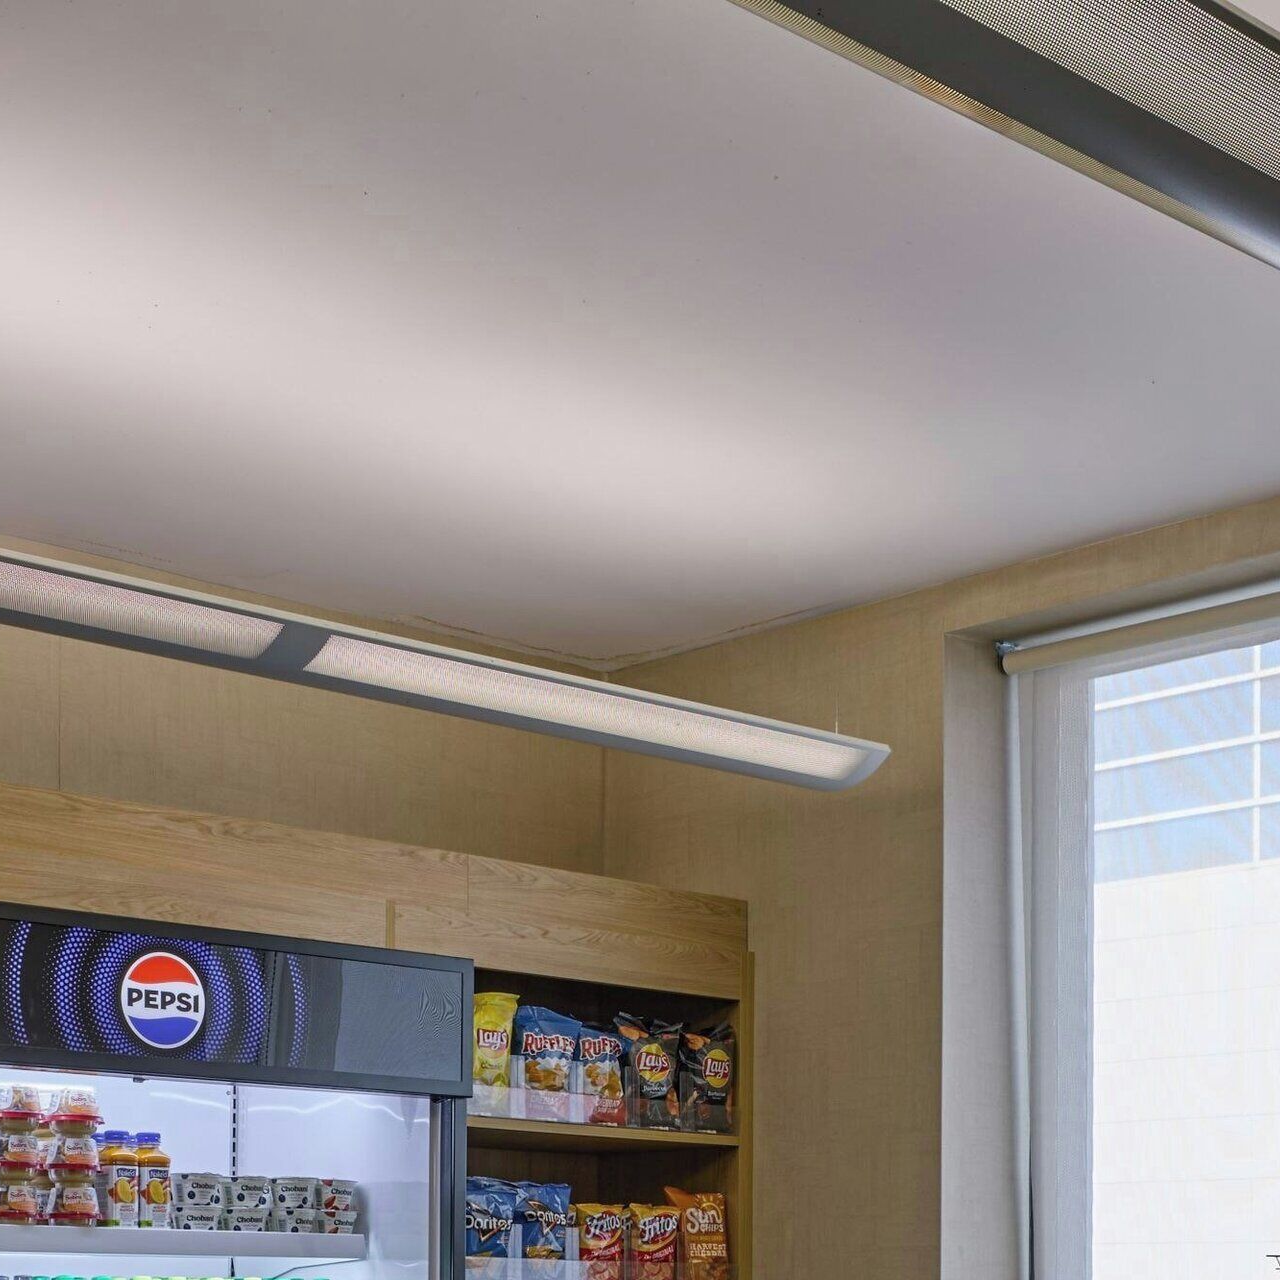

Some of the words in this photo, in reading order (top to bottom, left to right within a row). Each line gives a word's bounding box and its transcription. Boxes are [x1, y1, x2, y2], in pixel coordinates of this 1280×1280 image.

[127, 988, 199, 1013] PEPSI
[638, 1052, 670, 1071] Lay's
[705, 1059, 730, 1074] Lay's
[465, 1213, 514, 1231] Doritos
[524, 1211, 567, 1226] Doritos
[585, 1214, 620, 1239] Fritos
[639, 1214, 678, 1242] Fritos
[686, 1208, 720, 1233] Sun
